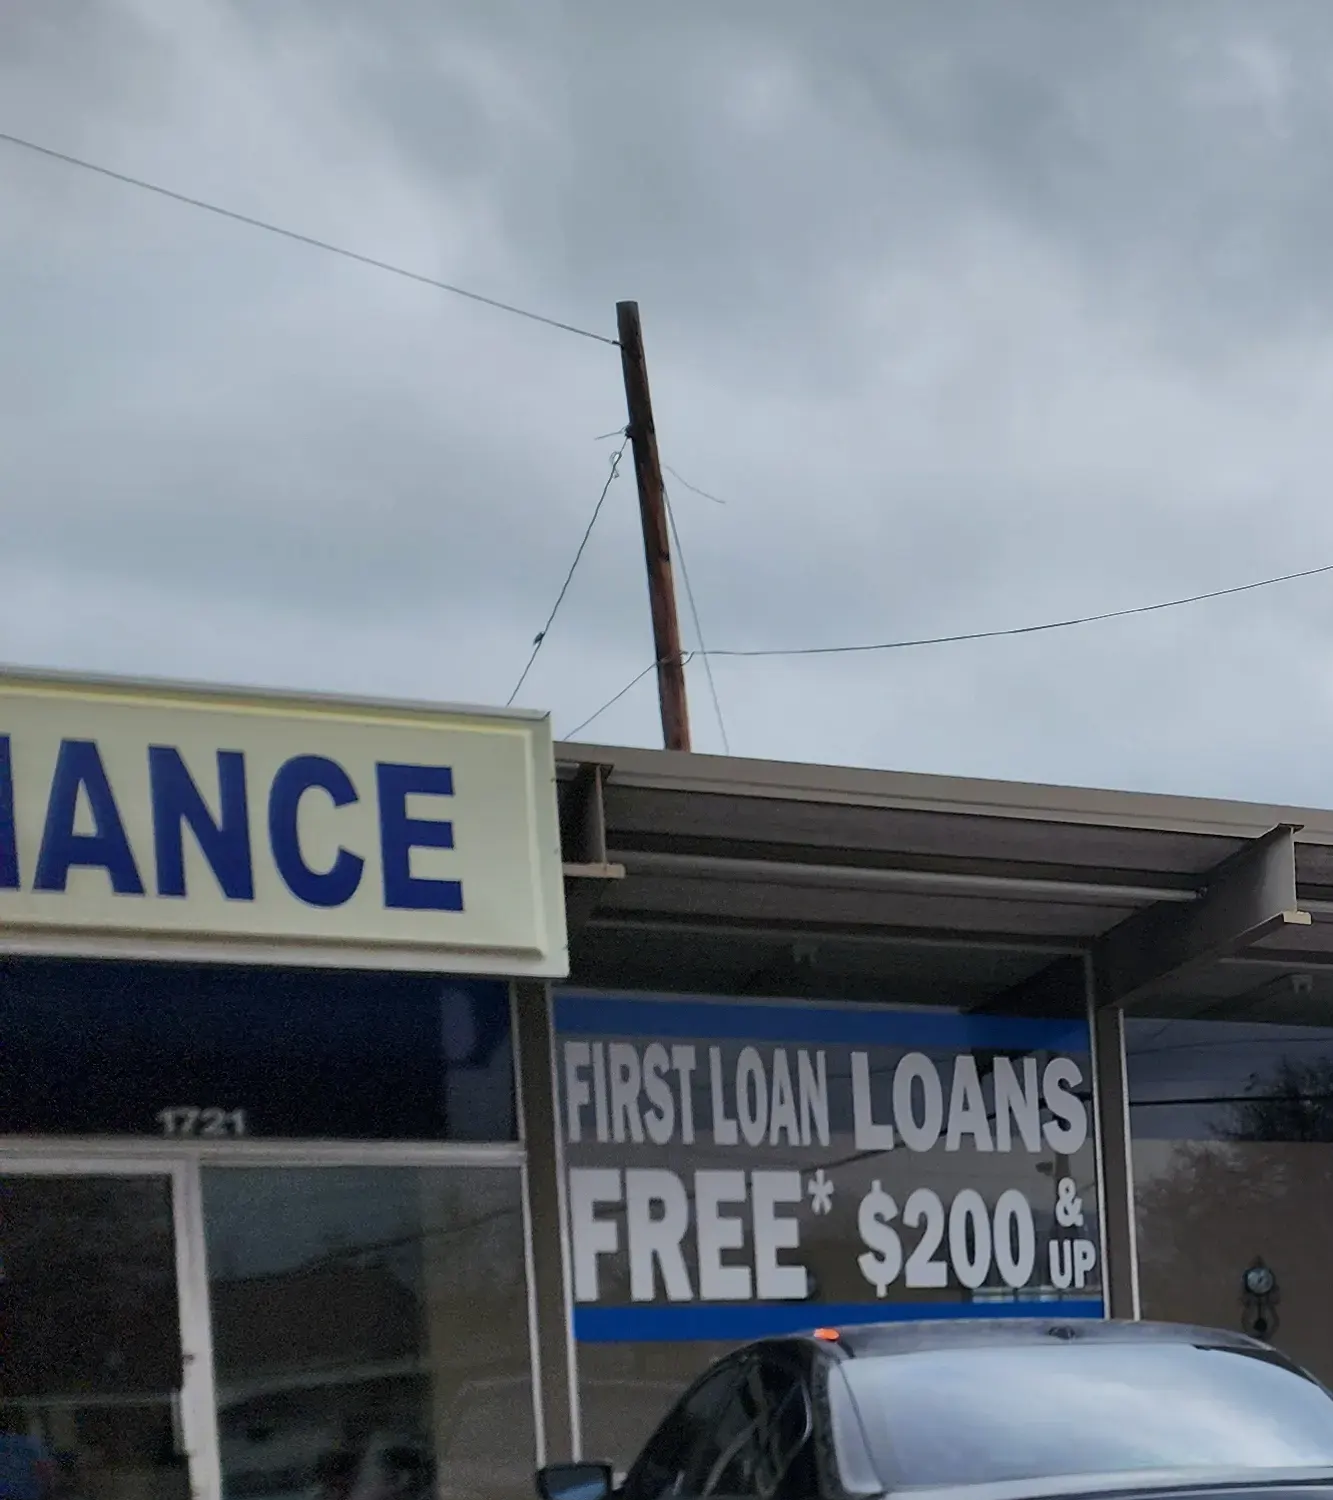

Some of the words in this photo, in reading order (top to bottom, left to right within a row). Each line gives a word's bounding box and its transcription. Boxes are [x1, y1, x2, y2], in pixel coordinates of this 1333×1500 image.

[0, 733, 464, 912] ANCE
[157, 1107, 246, 1137] 1721
[564, 1041, 696, 1144] FIRST
[709, 1047, 831, 1147] LOAN
[851, 1051, 1088, 1154] LOANS
[857, 1179, 1036, 1298] $200
[1055, 1177, 1084, 1228] &
[1049, 1239, 1096, 1289] UP
